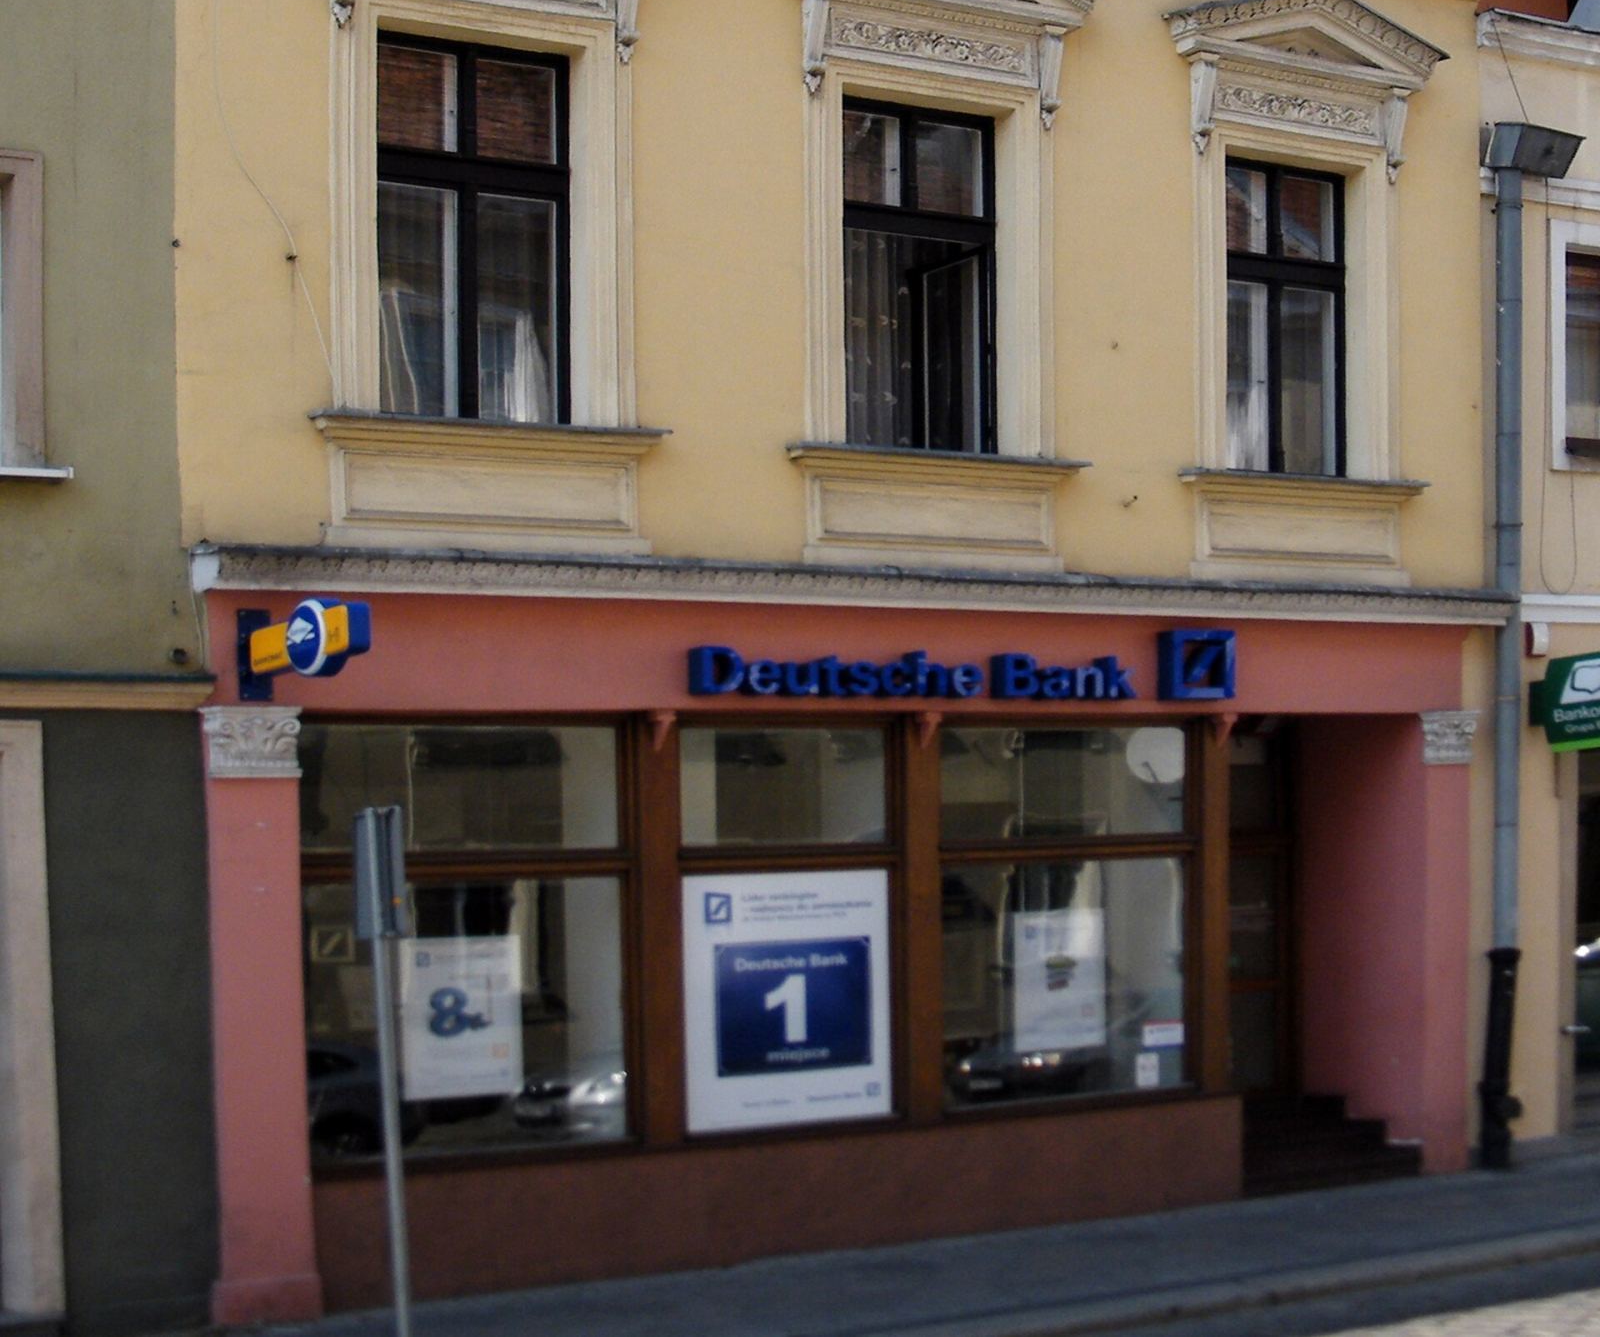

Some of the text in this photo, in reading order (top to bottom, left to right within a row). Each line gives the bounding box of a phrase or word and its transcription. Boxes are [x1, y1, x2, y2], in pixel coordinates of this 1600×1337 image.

[688, 645, 1136, 699] Deutsche Bank
[733, 952, 848, 973] Deutsche Bank
[764, 974, 807, 1043] 1
